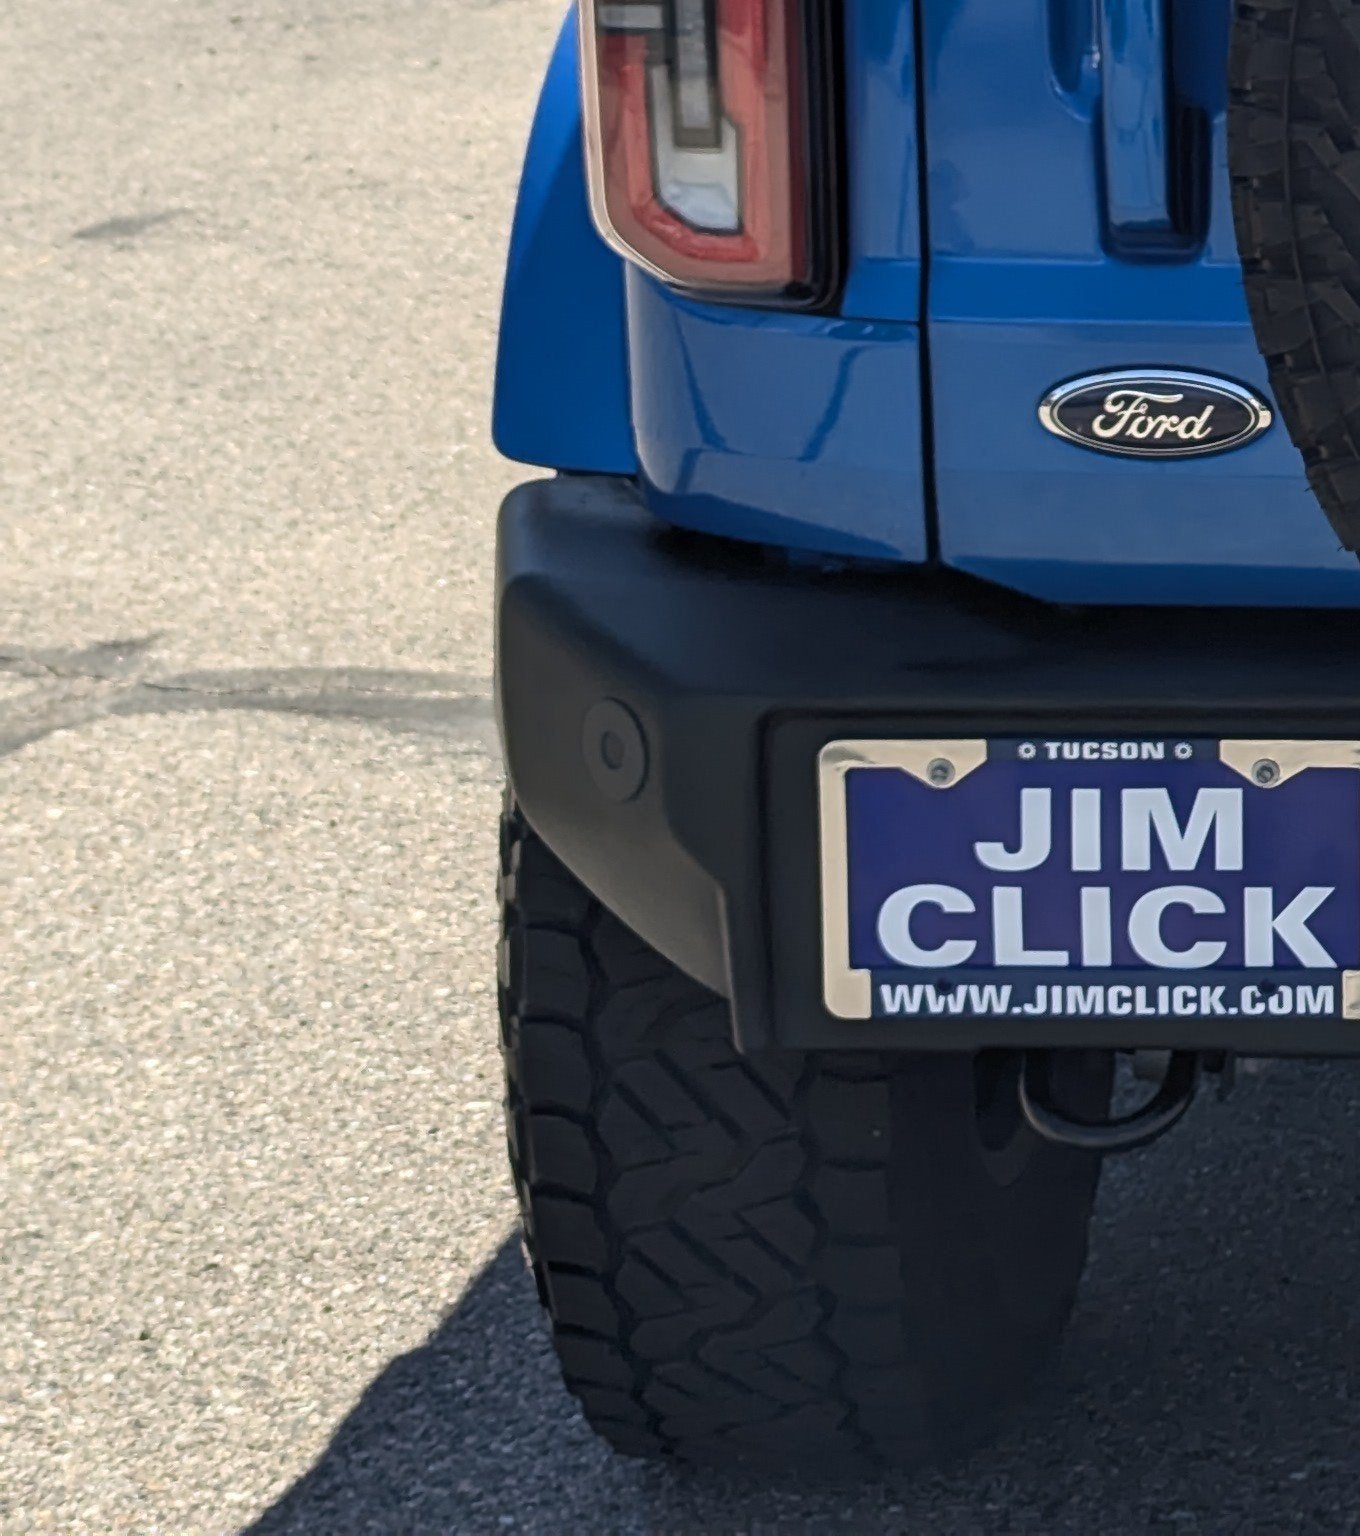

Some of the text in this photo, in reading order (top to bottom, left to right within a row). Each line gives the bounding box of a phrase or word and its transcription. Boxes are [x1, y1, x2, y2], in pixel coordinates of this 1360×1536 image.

[1091, 389, 1215, 440] Ford
[1043, 741, 1166, 761] TUCSON
[973, 786, 1244, 872] JIM
[876, 882, 1338, 969] CLICK
[879, 983, 1336, 1017] WWW.JIMCLICK.COM
